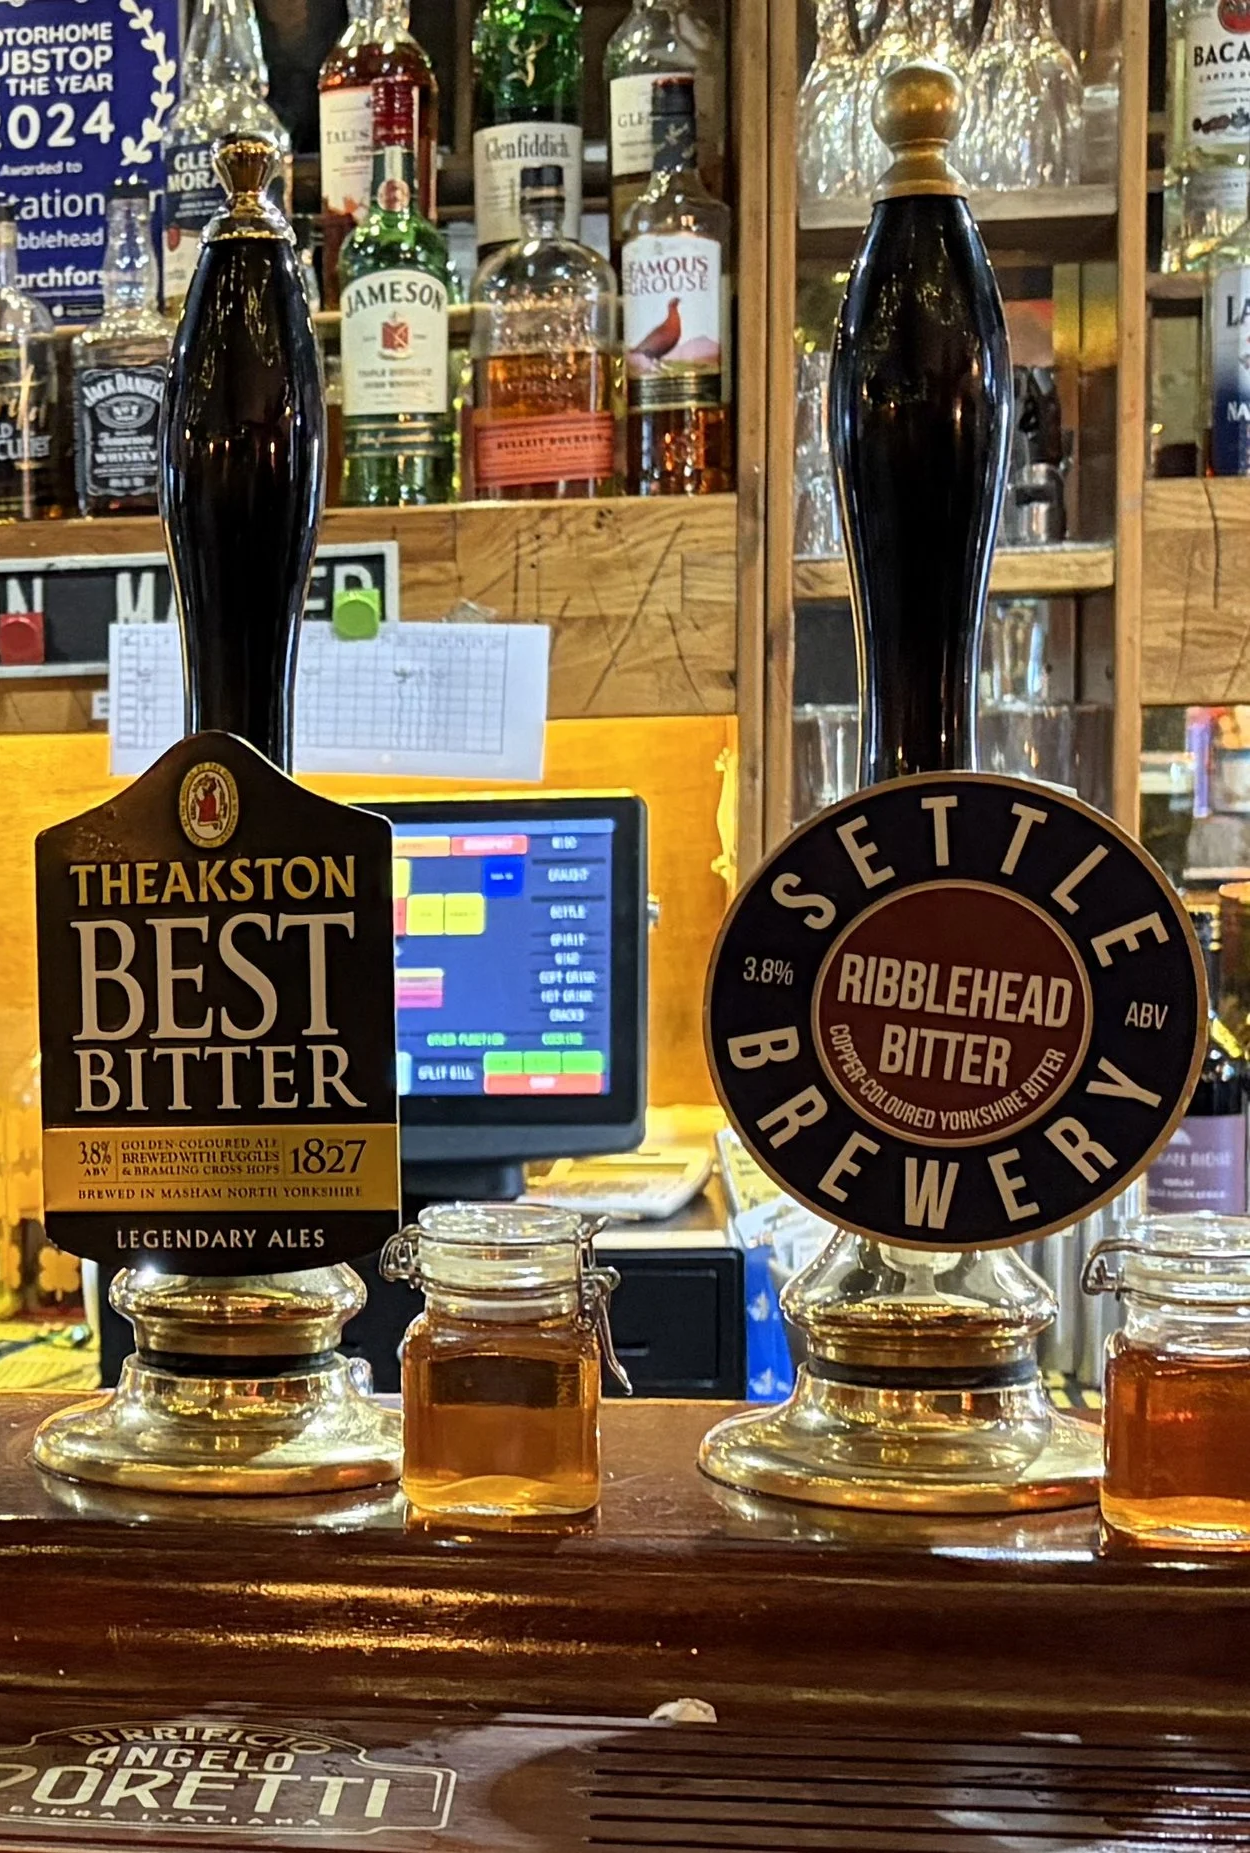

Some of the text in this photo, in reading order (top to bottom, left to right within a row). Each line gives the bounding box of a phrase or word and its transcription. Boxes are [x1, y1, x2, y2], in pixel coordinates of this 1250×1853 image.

[1193, 41, 1250, 67] BACA
[6, 77, 50, 97] THE
[55, 73, 114, 94] YEAR
[0, 161, 83, 177] Awarded to
[174, 151, 212, 172] GLE
[16, 228, 104, 250] bblehead
[629, 255, 709, 278] FAMOUS
[345, 281, 443, 318] JAMESON
[630, 275, 709, 297] GROUSE
[69, 855, 357, 907] THEAKSTON
[770, 795, 1170, 968] SETTLE
[70, 911, 355, 1041] BEST
[742, 956, 795, 986] 3.8%
[837, 952, 1074, 1029] RIBBLEHEAD
[1124, 1002, 1169, 1031] ABV
[878, 1023, 1013, 1088] BITTER
[73, 1045, 368, 1113] BITTER
[829, 1023, 1067, 1132] COPPER-COLOURED YORKSHIRE BITTER
[726, 1025, 1163, 1230] BREWERY
[78, 1141, 111, 1165] 3.8%
[121, 1150, 280, 1165] BREWED WITH FUGGLES
[290, 1138, 368, 1175] 1827
[84, 1168, 108, 1177] ABV
[122, 1164, 280, 1177] & BRAMLING CROSS HOPS
[78, 1185, 363, 1200] BREWED IN MASHAM NORTH YORKSHIRE
[117, 1228, 326, 1250] LEGENDARY ALES
[69, 1726, 331, 1755] BIRRIFICIO
[85, 1745, 295, 1773] ANGELO
[9, 1804, 322, 1827] BIRRA ITALIANA
